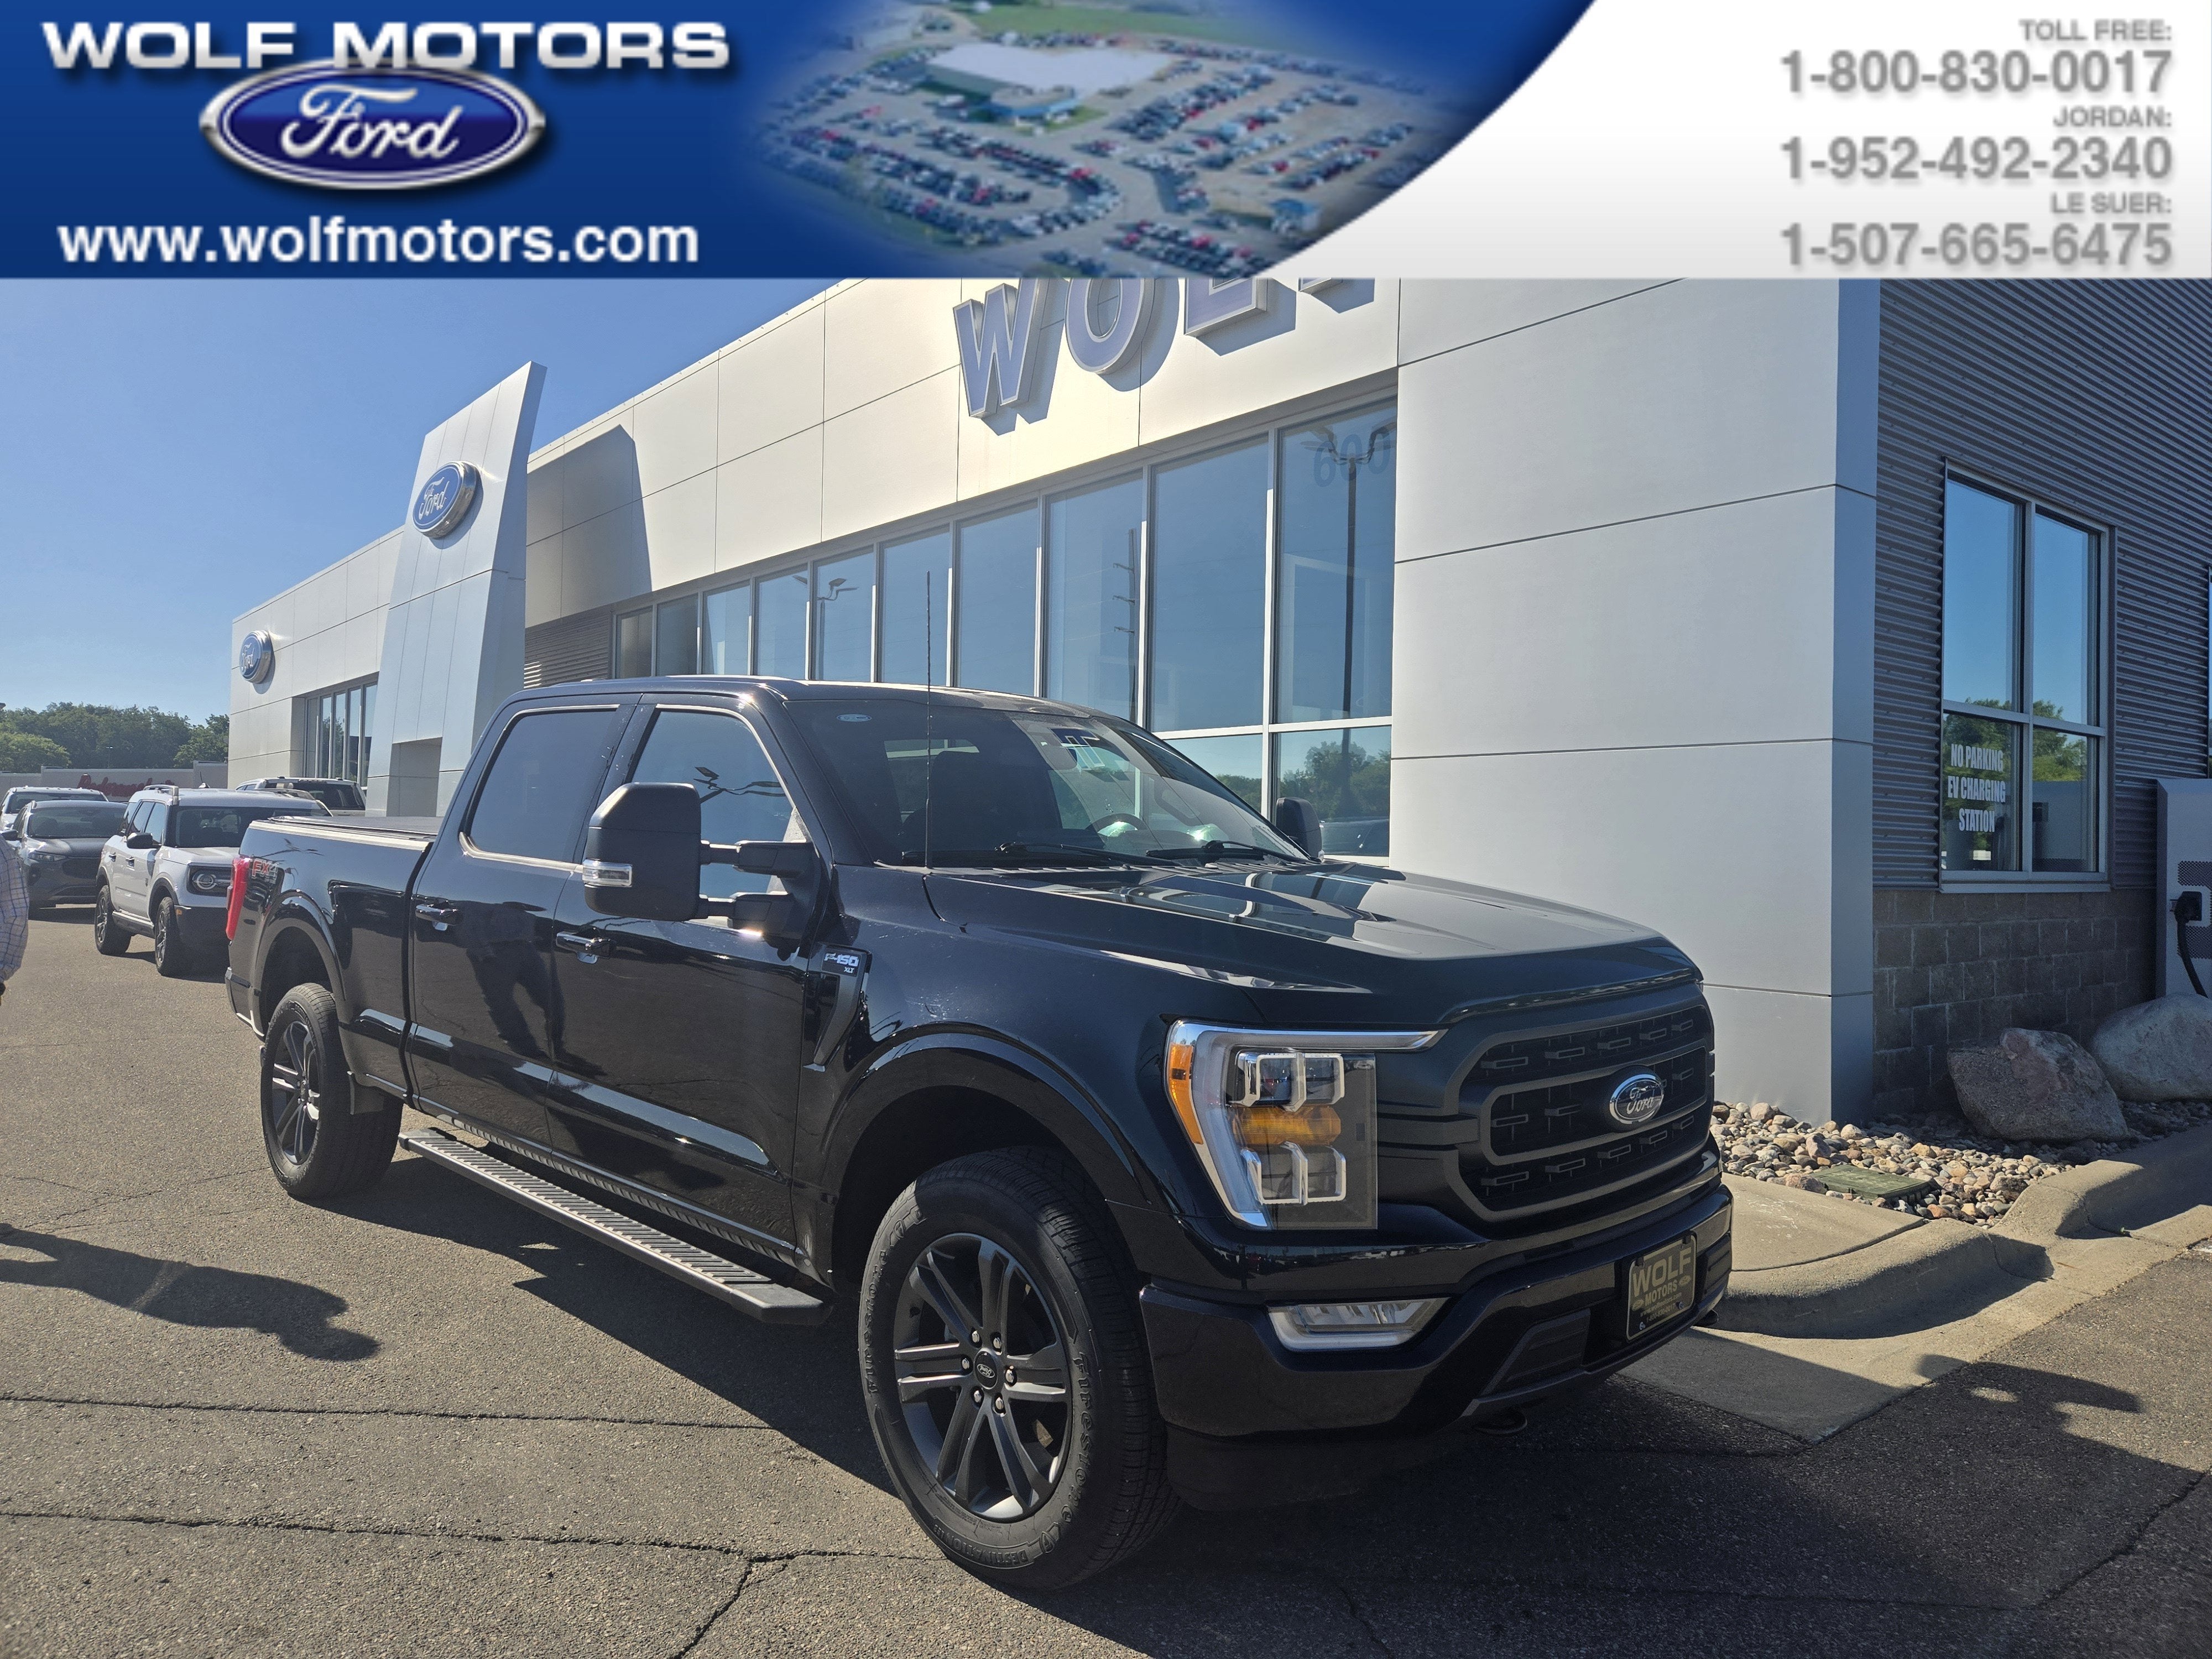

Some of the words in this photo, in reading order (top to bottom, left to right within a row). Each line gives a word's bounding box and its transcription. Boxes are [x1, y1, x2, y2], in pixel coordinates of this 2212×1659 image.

[953, 278, 1344, 419] WOL
[419, 477, 450, 520] Ford
[1951, 744, 1963, 767] NO
[1965, 746, 2004, 772] PARKING
[1948, 776, 1959, 799] EV
[1961, 777, 2006, 802] CHARGING
[1959, 808, 1995, 832] STATION
[252, 859, 279, 880] FX4
[824, 952, 859, 967] F-150
[1626, 1085, 1657, 1115] Ford
[1633, 1246, 1692, 1297] WOLF
[1645, 1279, 1678, 1306] MOTORS
[979, 1365, 992, 1377] Ford
[1062, 1352, 1093, 1522] Firestone
